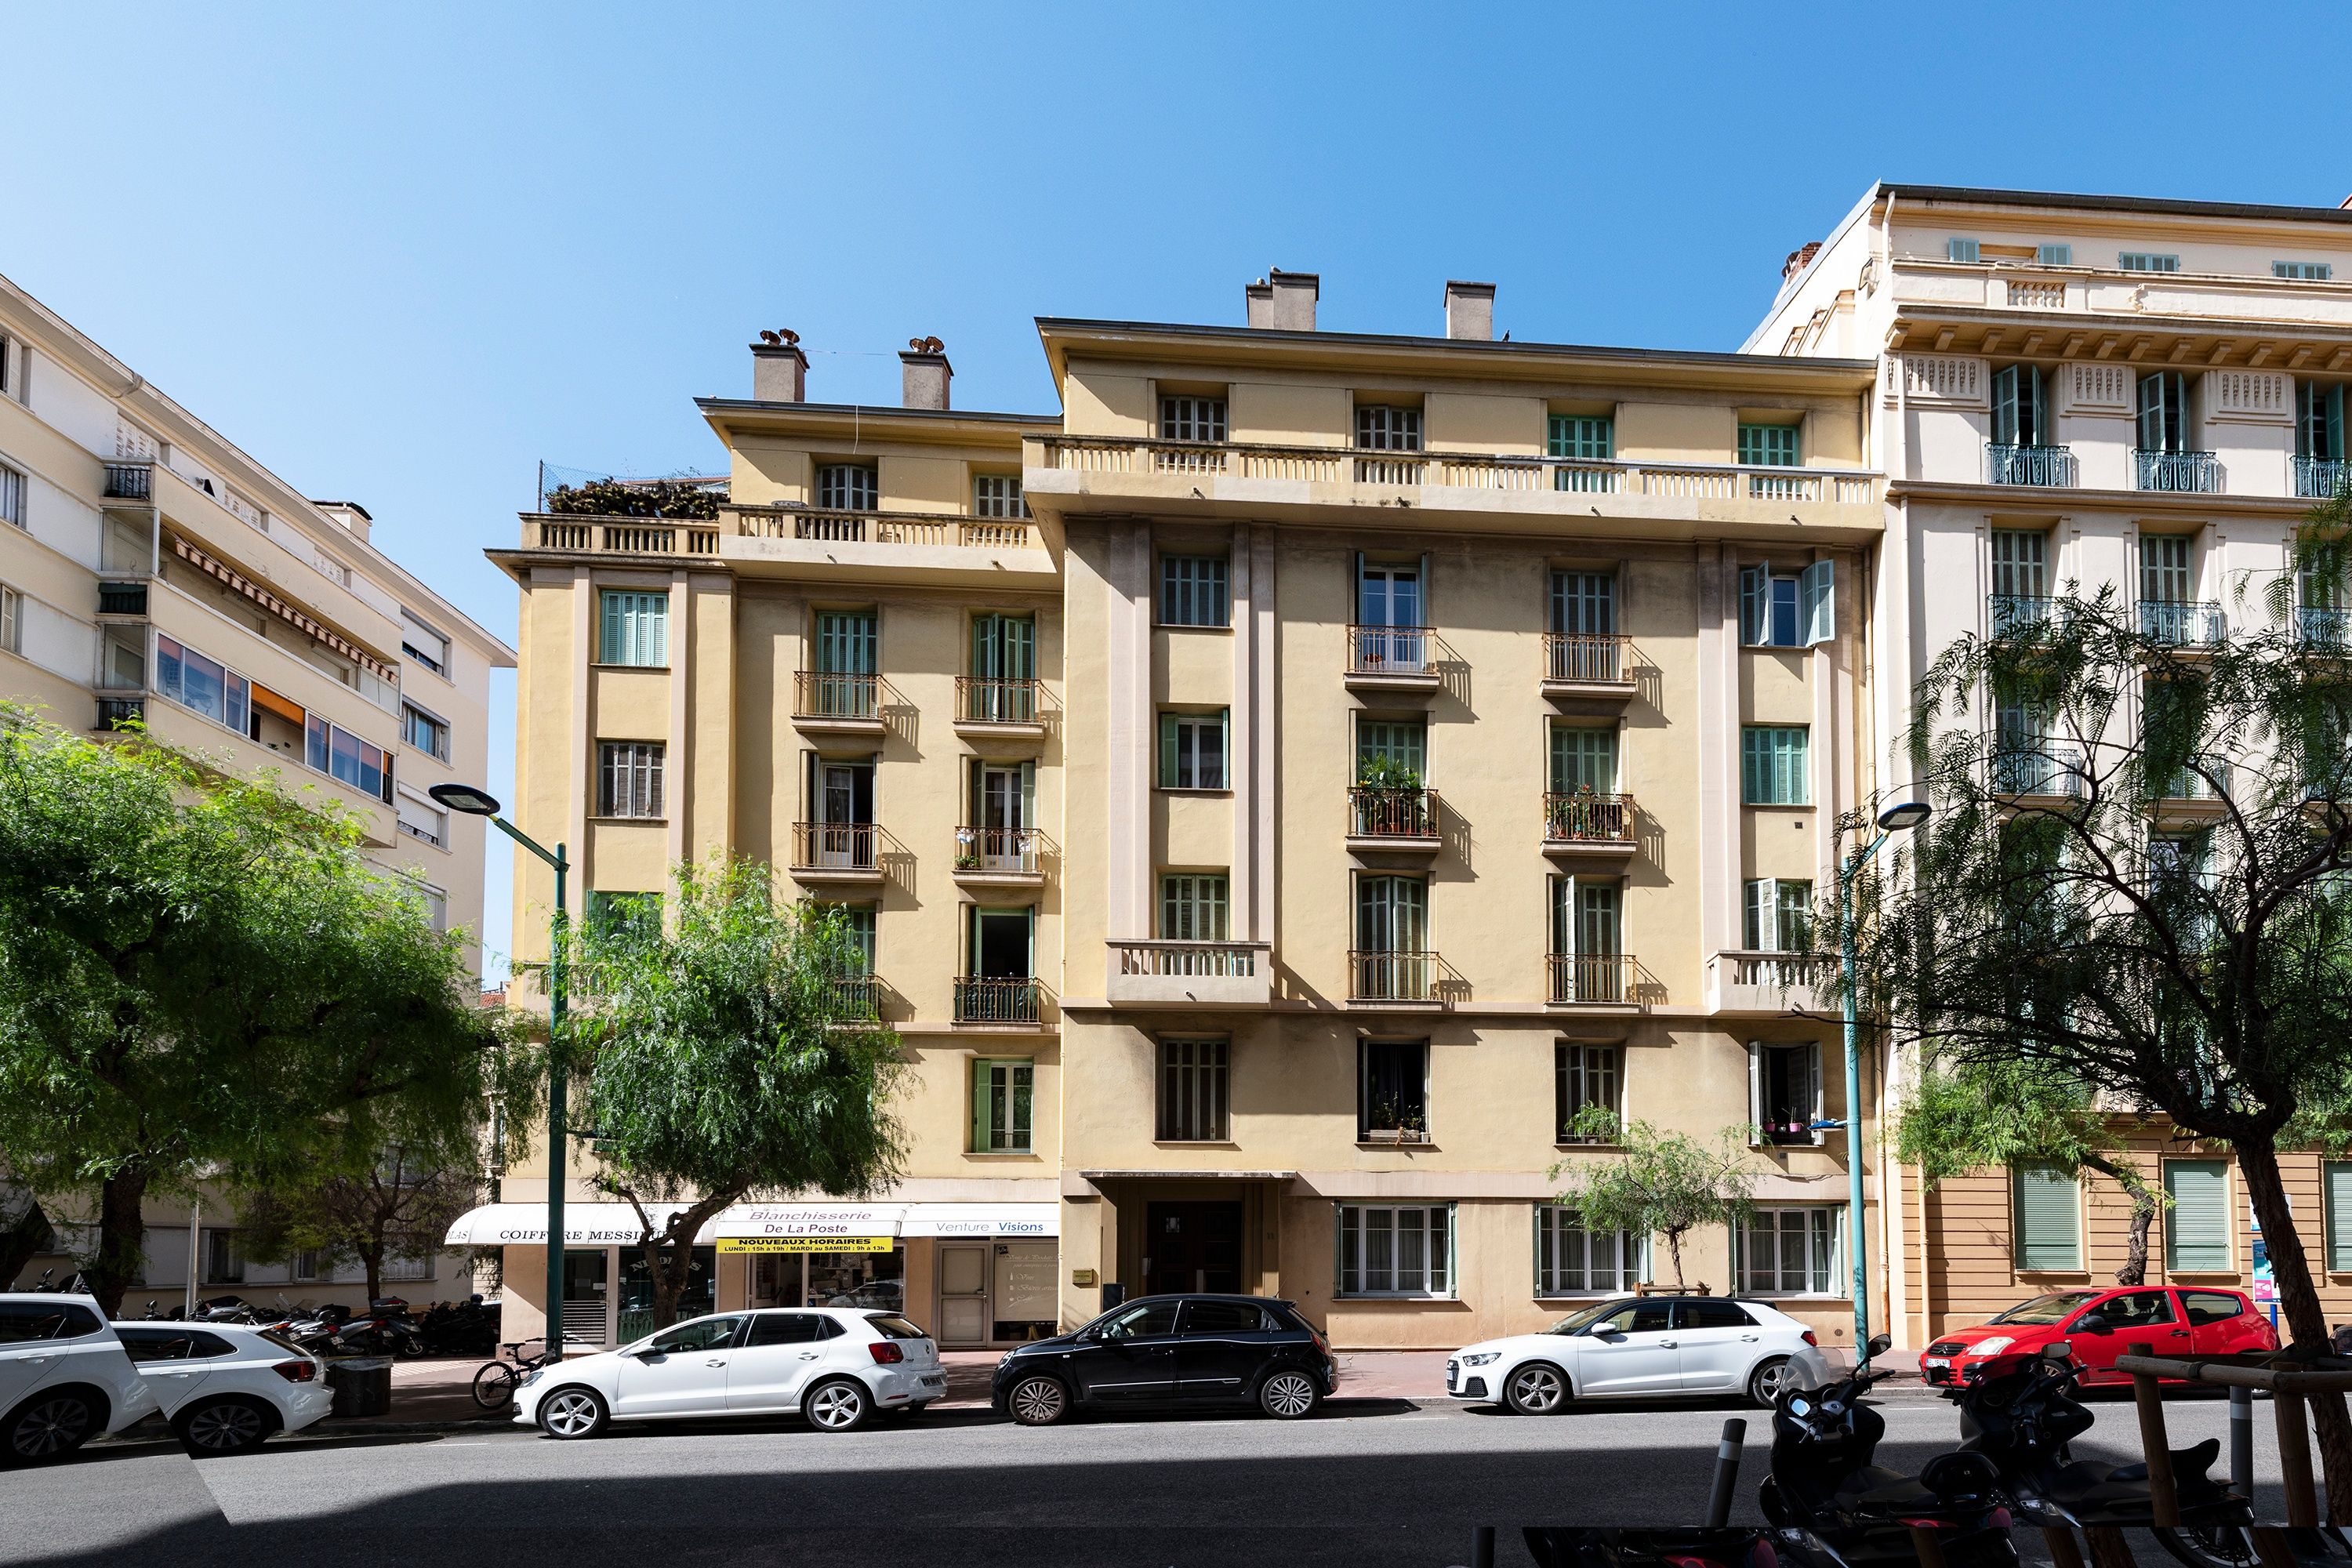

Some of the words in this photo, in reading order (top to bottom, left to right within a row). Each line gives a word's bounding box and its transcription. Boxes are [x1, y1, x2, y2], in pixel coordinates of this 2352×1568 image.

[750, 1211, 872, 1220] Blanchisserie
[764, 1224, 782, 1233] De
[787, 1224, 804, 1233] La
[808, 1223, 848, 1233] Poste
[936, 1222, 989, 1232] Venture
[999, 1221, 1044, 1231] Visions
[499, 1230, 583, 1240] COIFFRE
